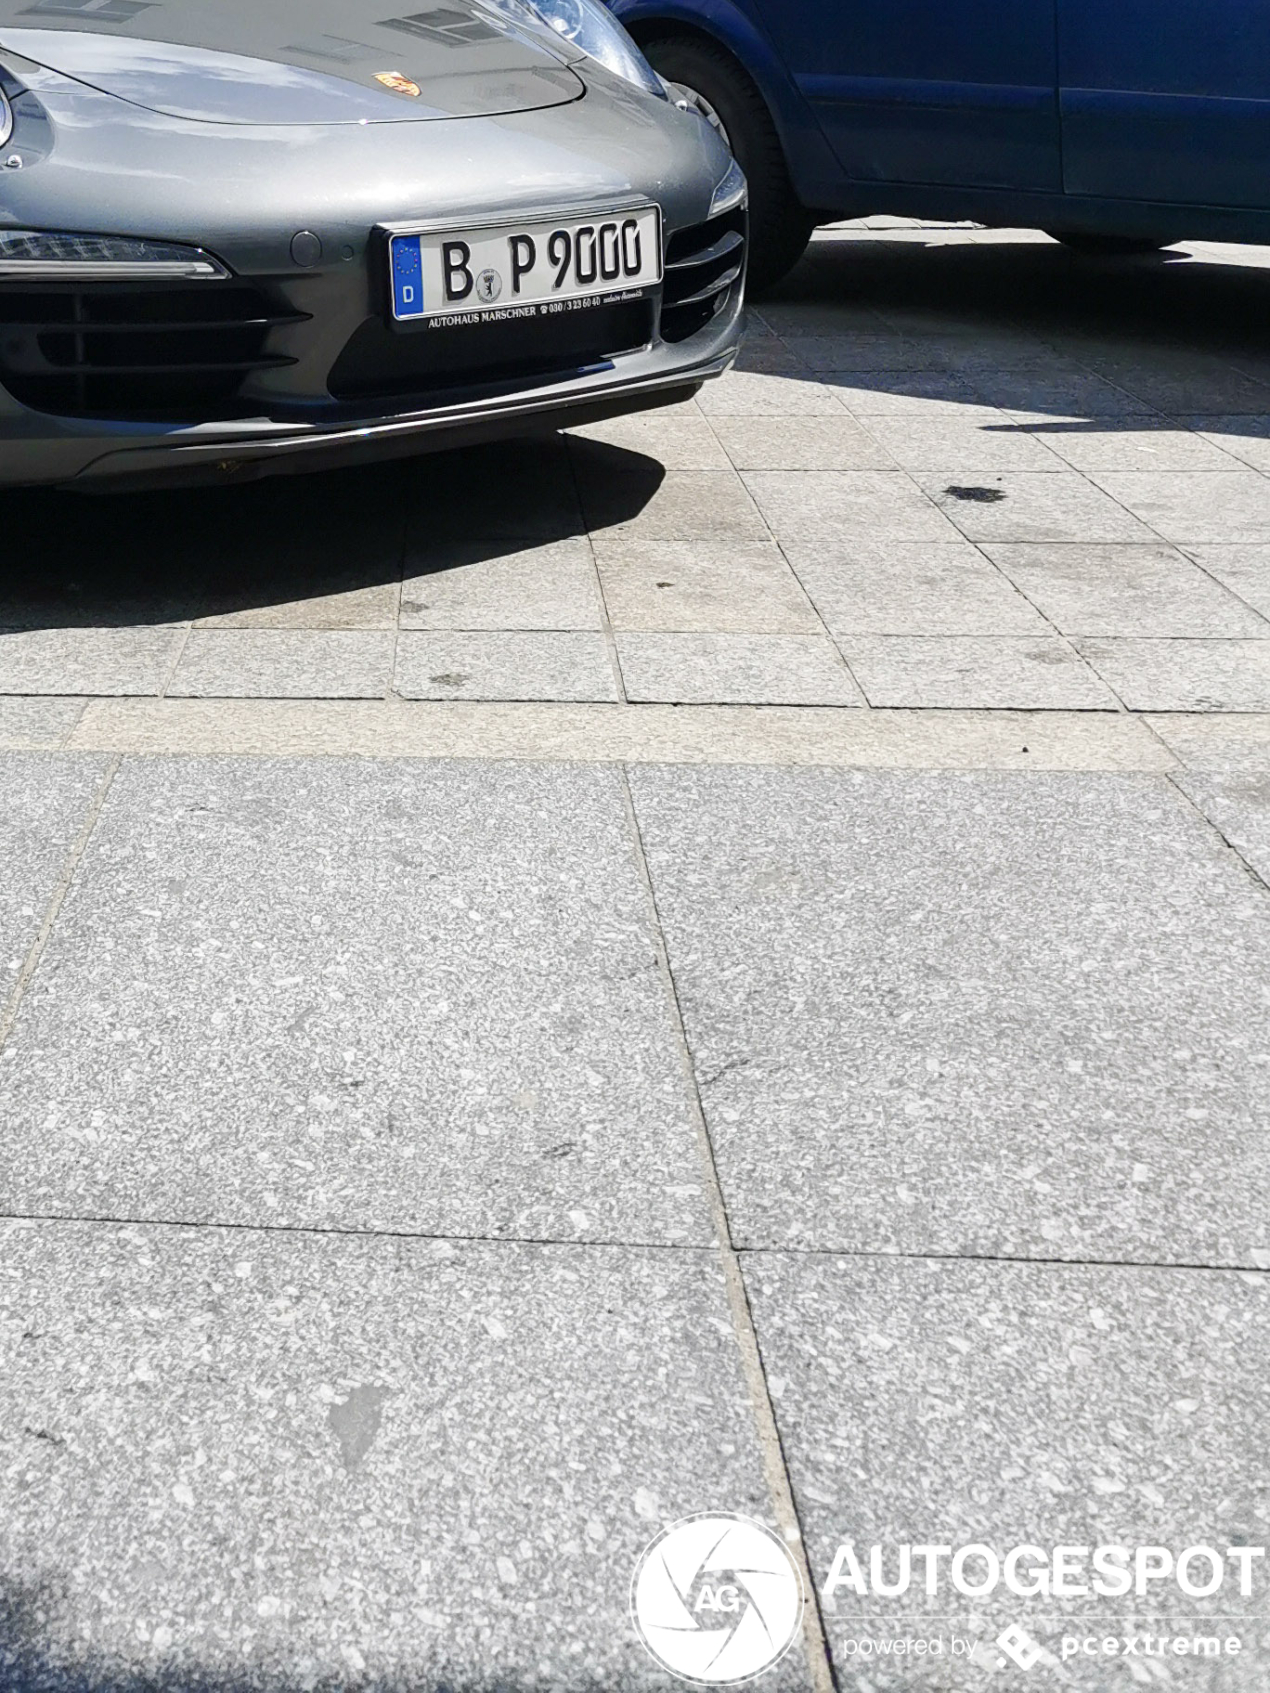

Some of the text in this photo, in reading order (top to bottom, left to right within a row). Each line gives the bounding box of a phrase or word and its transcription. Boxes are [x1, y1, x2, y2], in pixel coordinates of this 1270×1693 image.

[402, 285, 414, 304] D
[442, 240, 474, 302] B
[508, 233, 537, 294] P
[548, 218, 642, 291] 9000
[428, 313, 480, 329] AUTOHAUS
[481, 306, 536, 323] MARSCHNER
